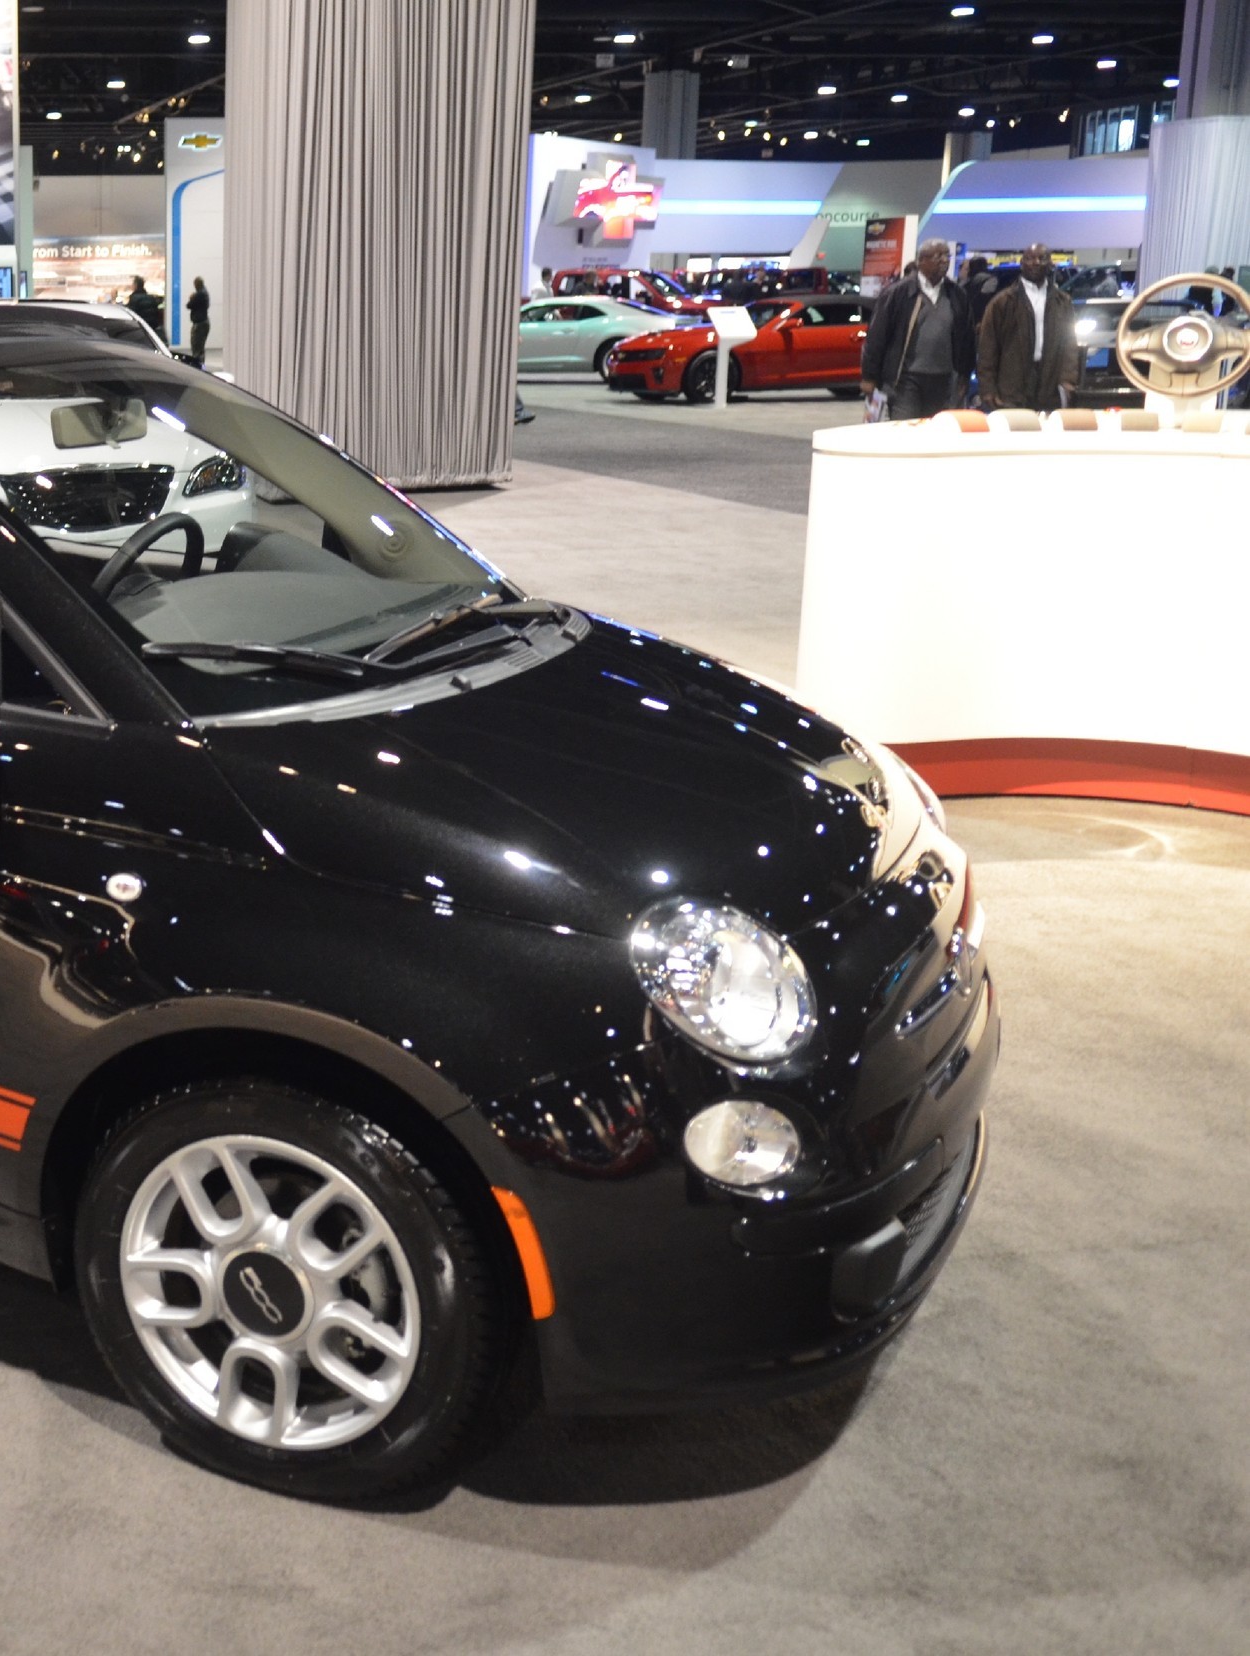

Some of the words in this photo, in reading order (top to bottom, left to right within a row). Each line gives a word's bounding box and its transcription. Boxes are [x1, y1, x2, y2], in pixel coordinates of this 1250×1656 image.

[33, 246, 59, 258] rom
[61, 245, 92, 258] Start
[94, 245, 109, 257] to
[111, 243, 153, 257] Finish.
